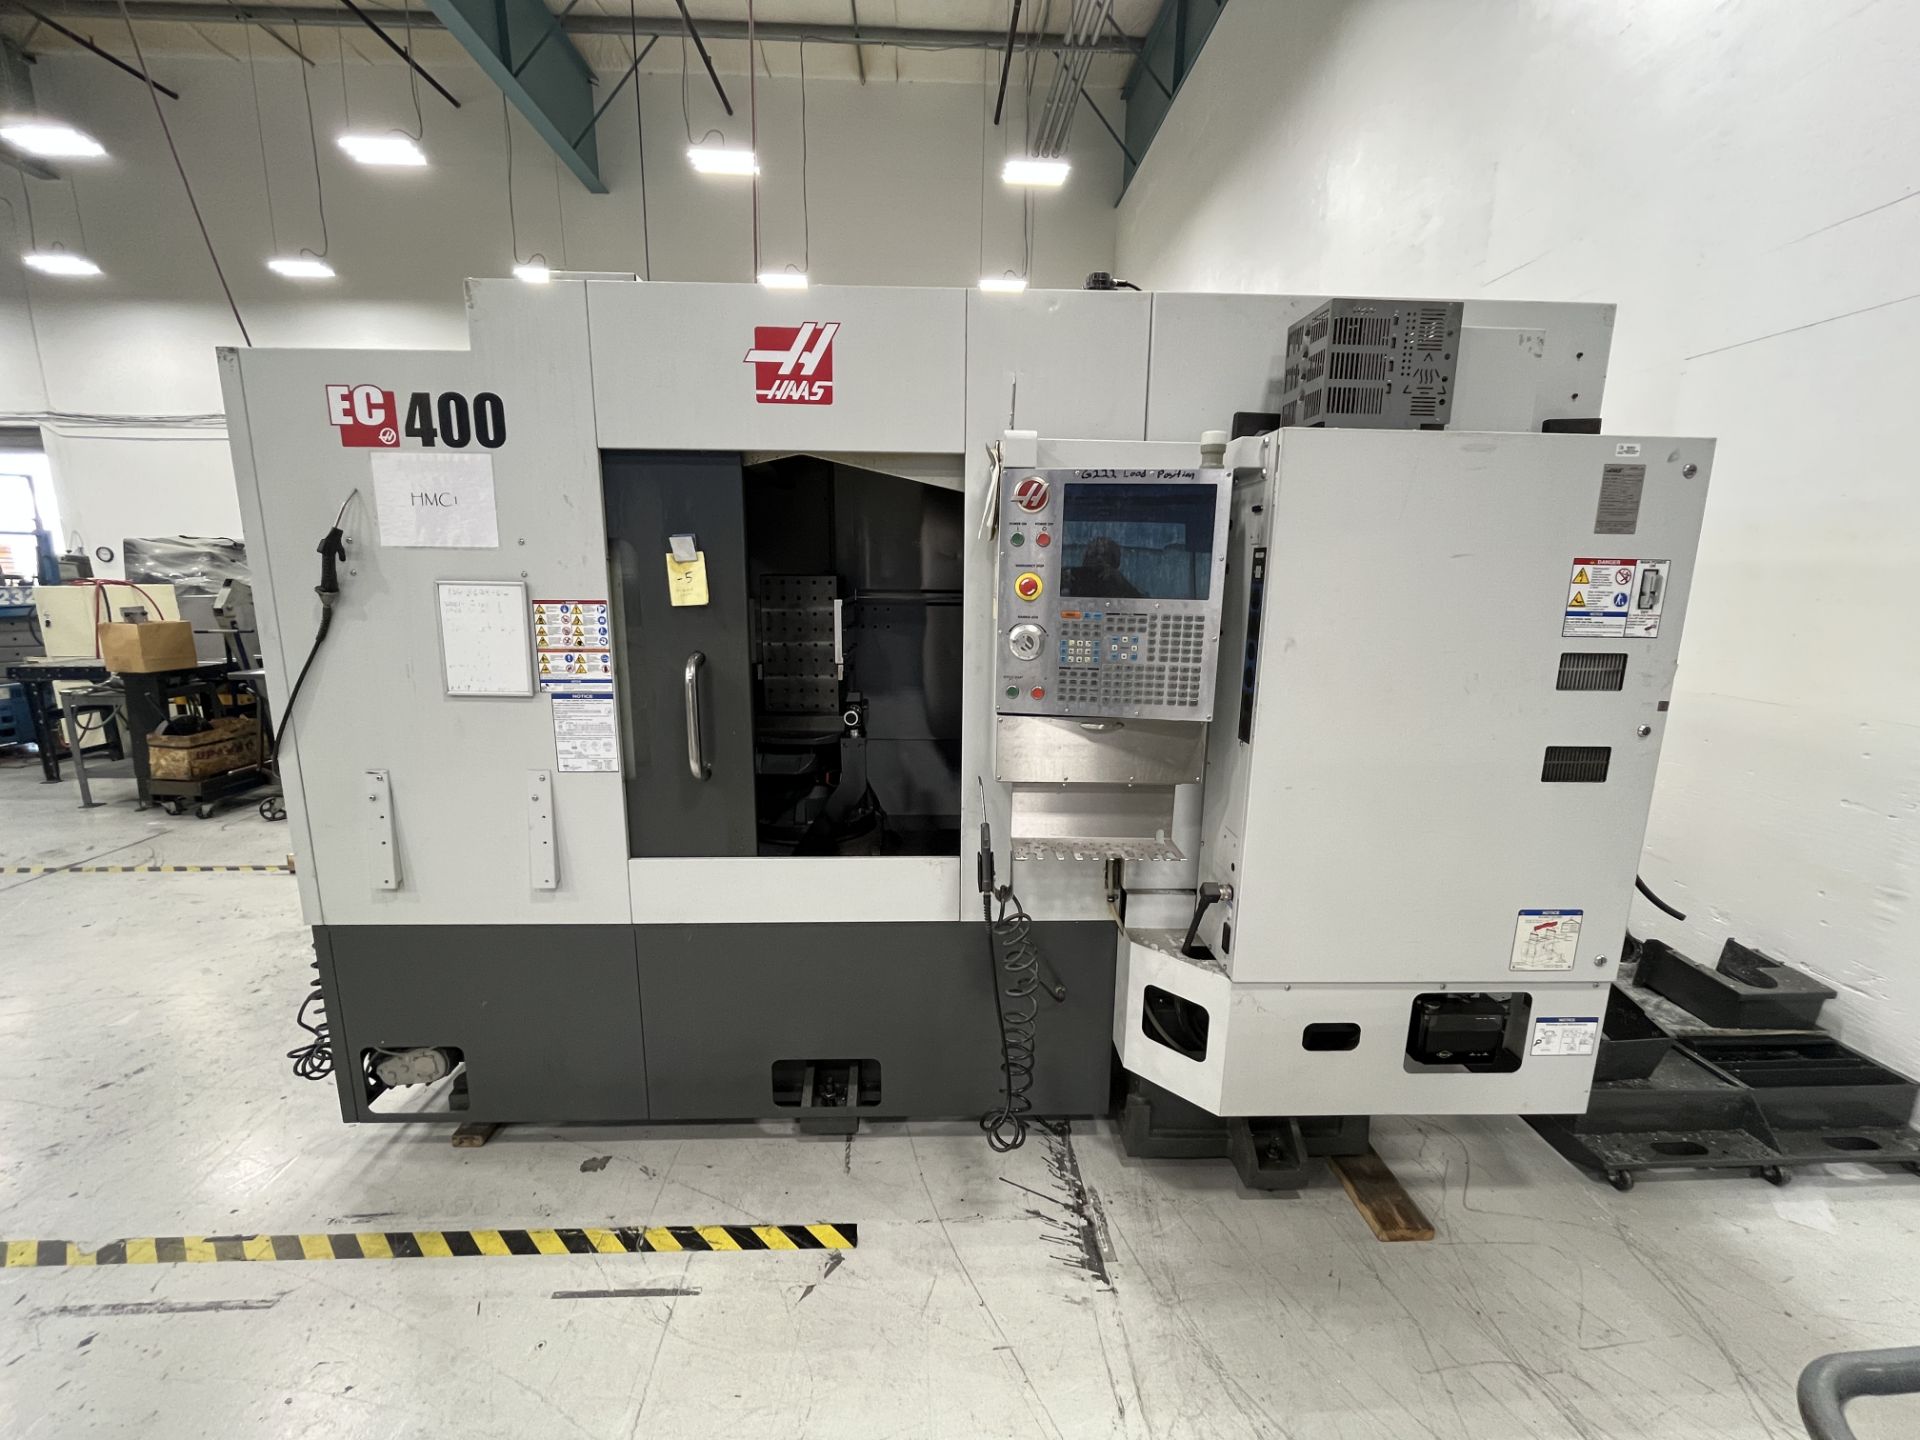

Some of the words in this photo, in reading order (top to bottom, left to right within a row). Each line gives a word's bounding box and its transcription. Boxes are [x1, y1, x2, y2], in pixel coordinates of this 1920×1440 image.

[756, 379, 832, 400] HAAS
[326, 384, 386, 426] EC
[405, 391, 506, 448] 400
[1123, 469, 1146, 478] Load
